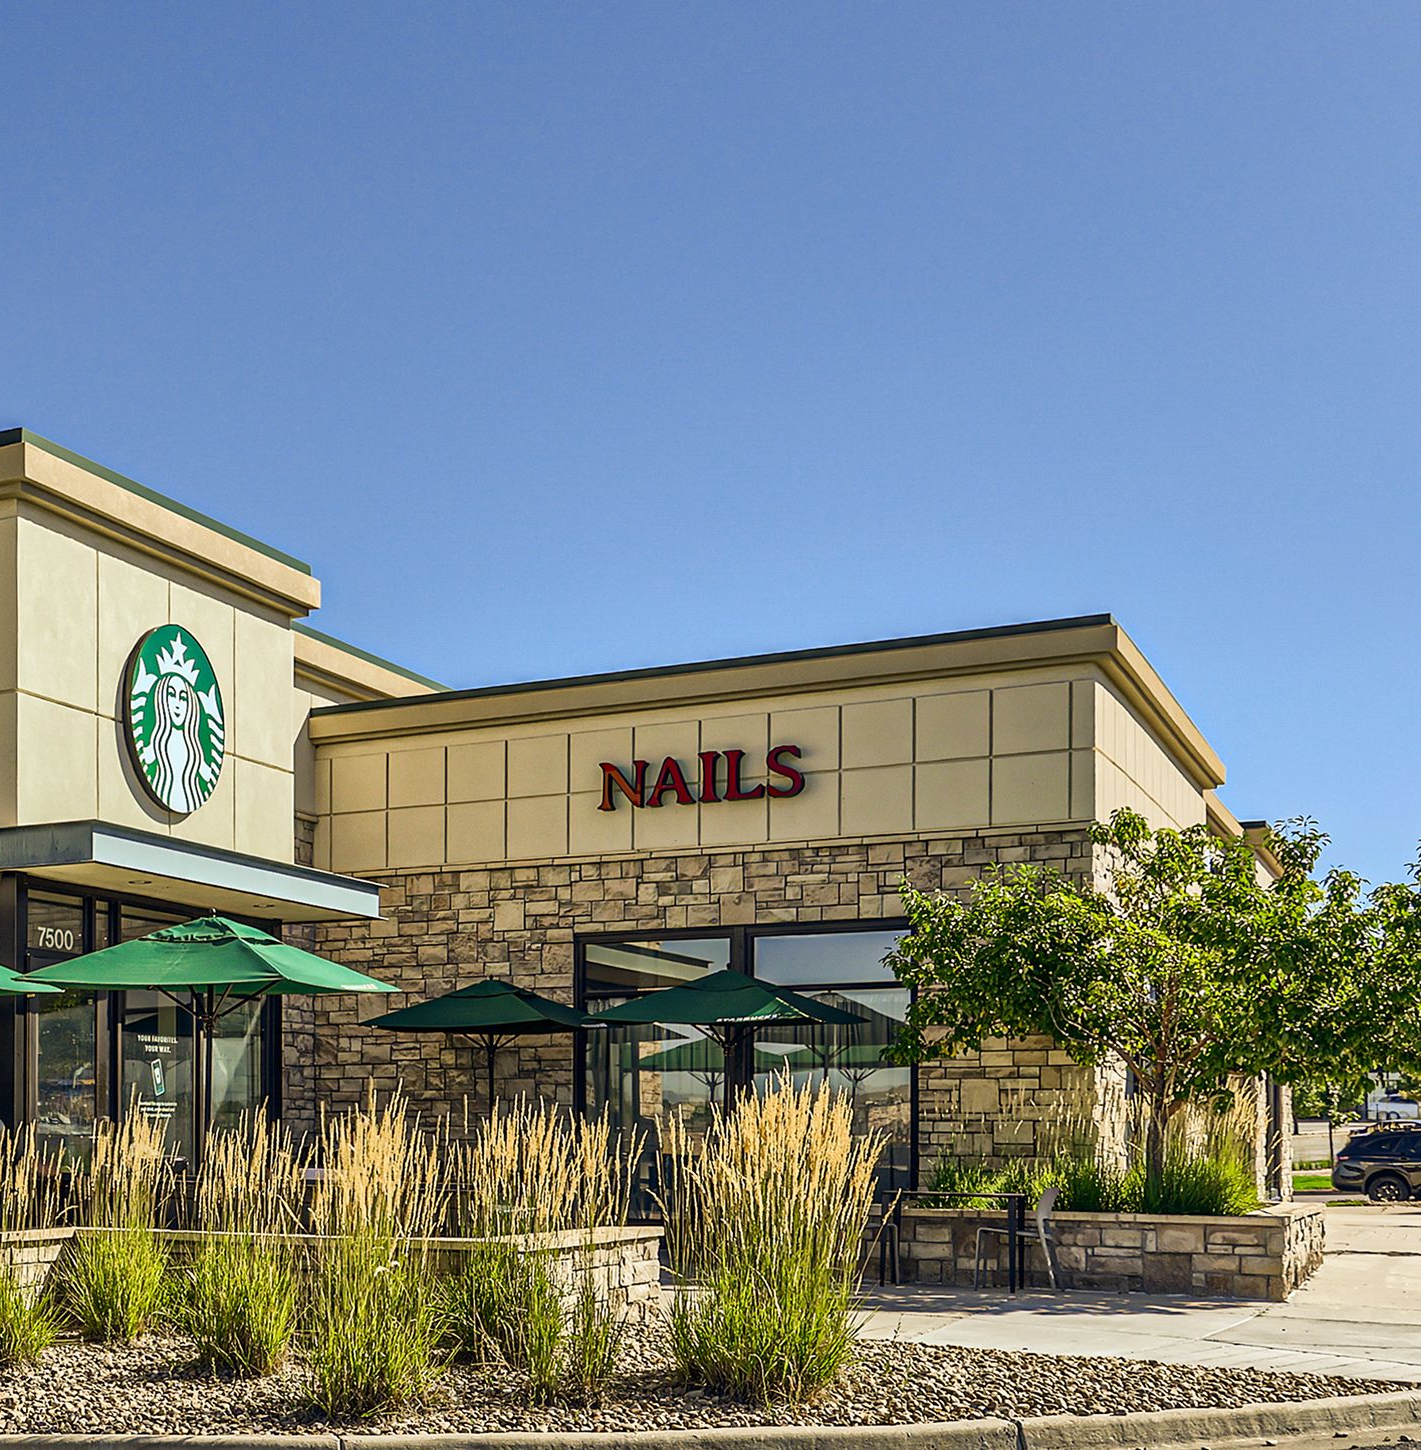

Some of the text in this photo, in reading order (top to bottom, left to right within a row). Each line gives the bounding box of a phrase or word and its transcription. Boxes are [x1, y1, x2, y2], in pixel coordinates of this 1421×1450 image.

[597, 745, 805, 811] NAILS
[38, 926, 73, 950] 7500
[144, 1044, 158, 1052] YOUR
